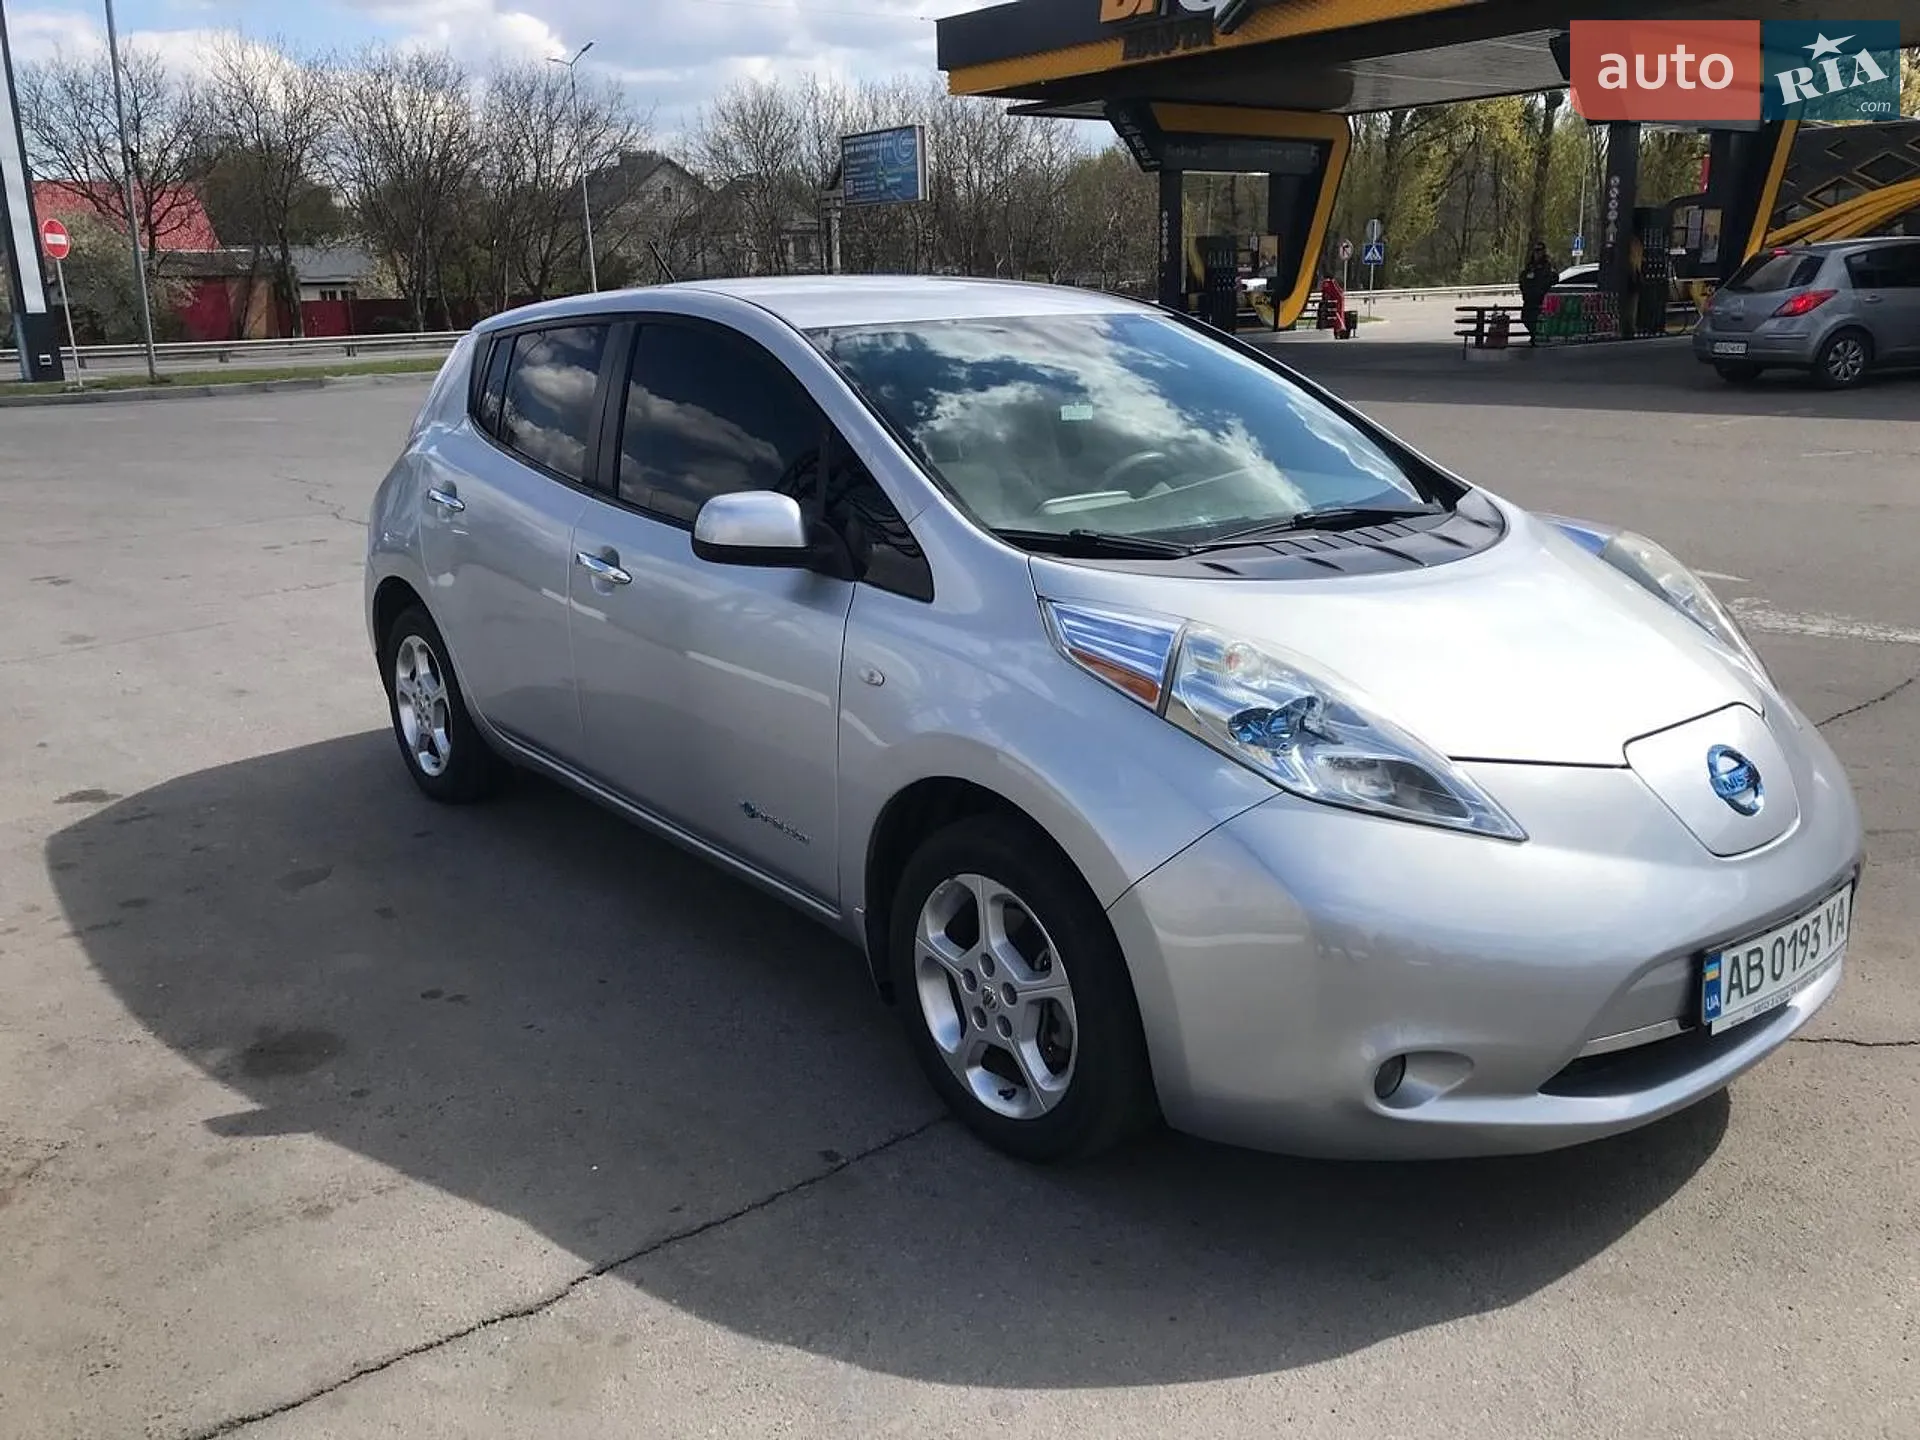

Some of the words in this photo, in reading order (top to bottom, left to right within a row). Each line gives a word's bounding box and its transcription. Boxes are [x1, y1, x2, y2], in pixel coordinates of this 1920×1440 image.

[1725, 946, 1764, 1004] AB
[1771, 914, 1821, 982] 0193
[1826, 896, 1845, 947] YA
[1706, 993, 1720, 1011] UA
